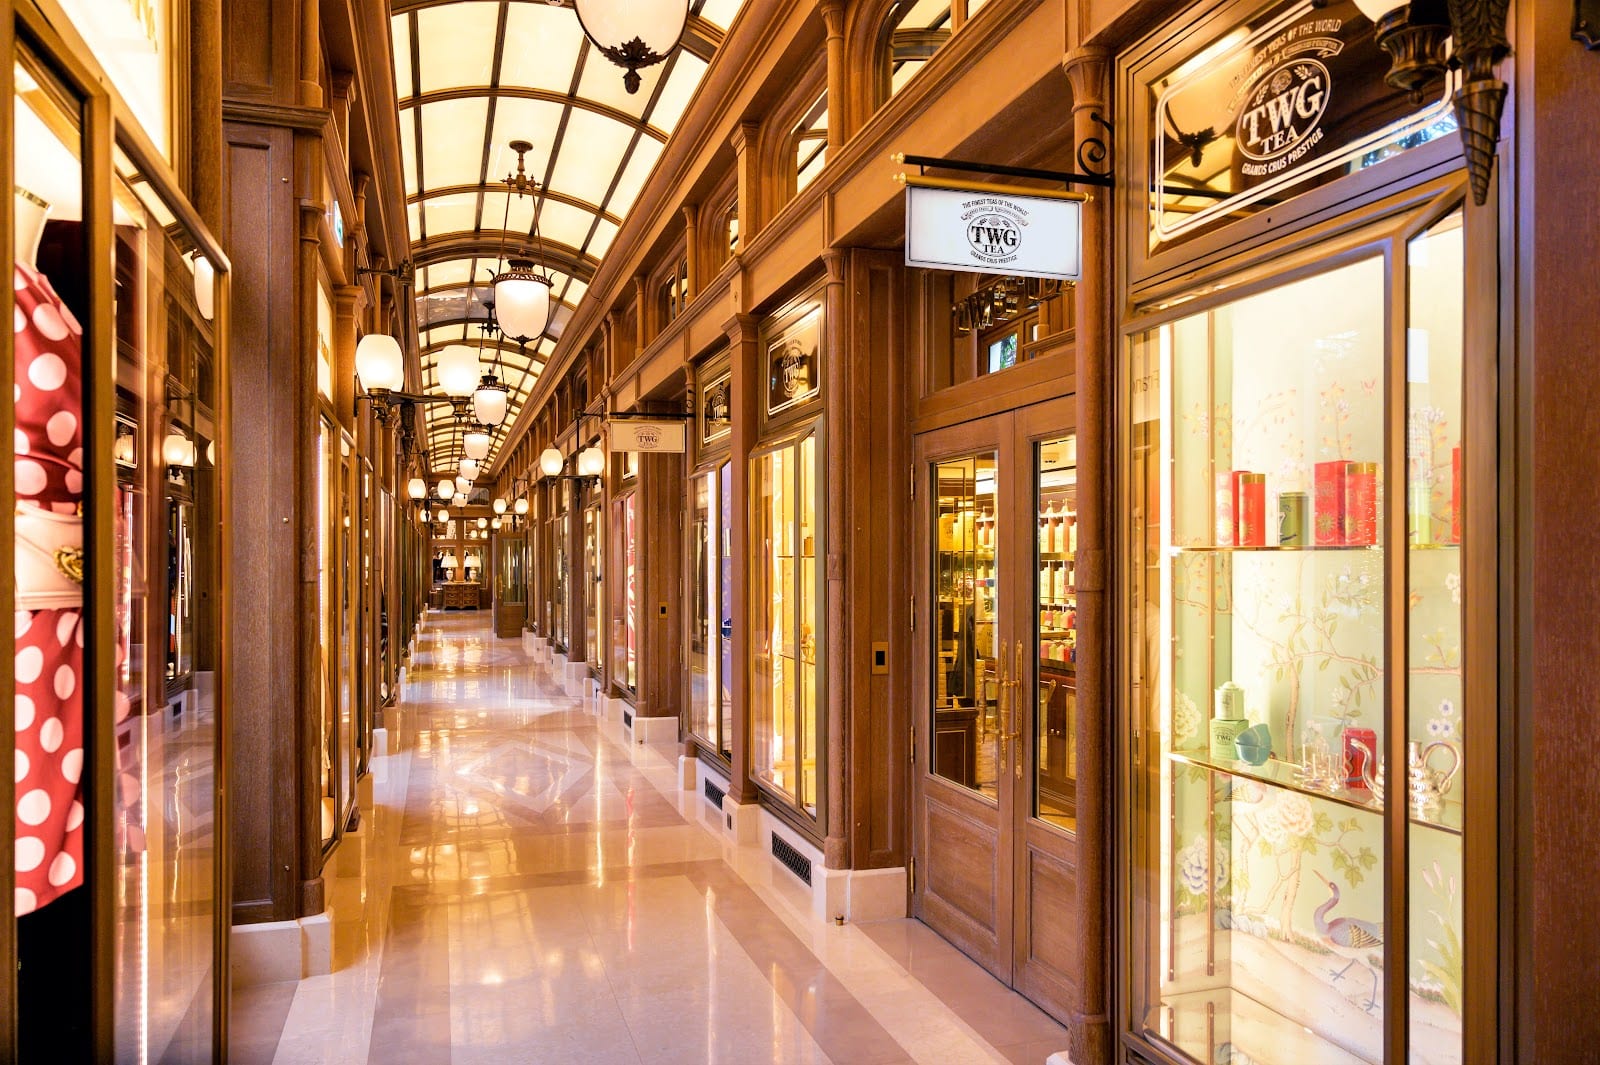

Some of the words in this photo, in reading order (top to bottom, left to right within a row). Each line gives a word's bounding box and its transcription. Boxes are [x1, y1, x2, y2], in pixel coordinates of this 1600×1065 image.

[1287, 27, 1298, 42] OF
[1298, 21, 1314, 36] THE
[1315, 19, 1342, 33] WORLD
[1242, 75, 1324, 147] TWG
[1260, 125, 1300, 155] TEA
[1241, 162, 1268, 176] GRANDS
[1267, 156, 1288, 174] CRUS
[1287, 127, 1324, 165] PRESTIGE
[1004, 200, 1013, 209] THE
[971, 225, 1017, 247] TWG
[982, 244, 1005, 254] TEA
[638, 435, 657, 443] TWG
